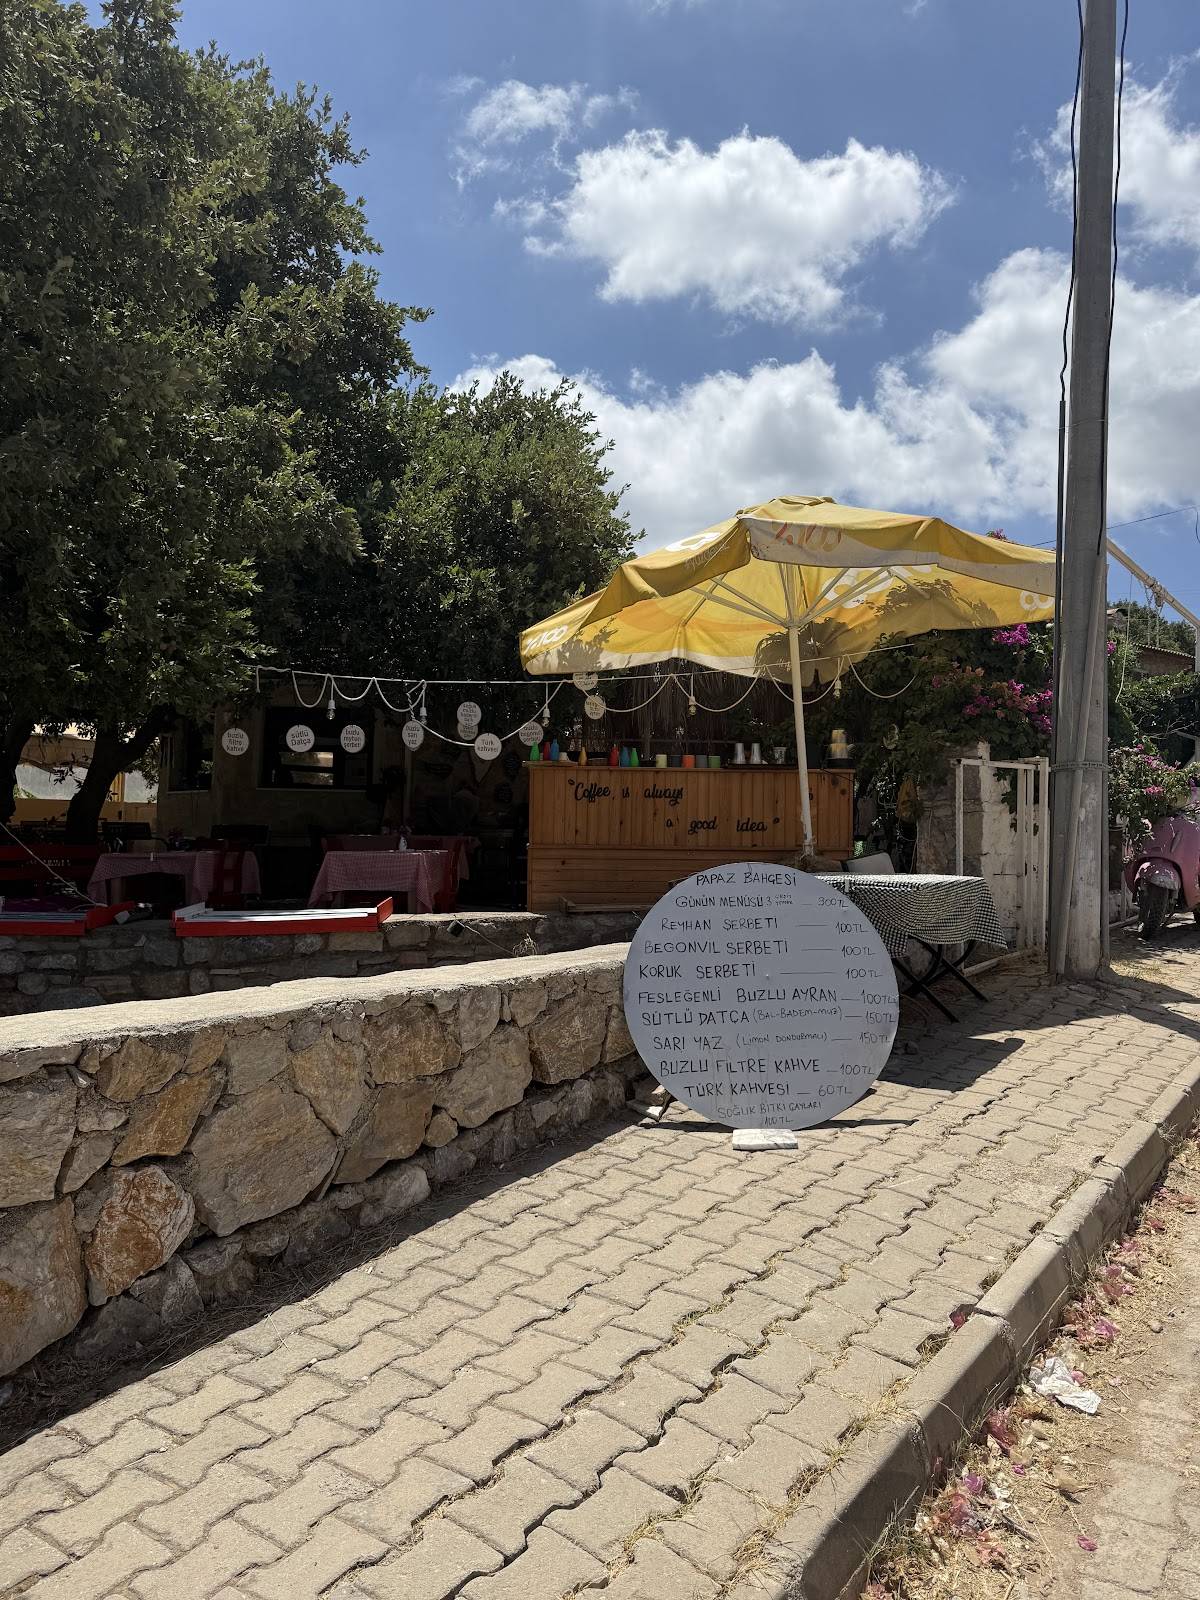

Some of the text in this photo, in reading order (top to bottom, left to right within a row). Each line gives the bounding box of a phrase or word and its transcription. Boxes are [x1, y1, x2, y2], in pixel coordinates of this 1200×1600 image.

[574, 782, 611, 804] Coffee
[644, 784, 684, 807] always
[666, 816, 768, 835] a good idea
[696, 872, 737, 886] PAPAZ
[661, 917, 712, 932] REYHAN
[639, 964, 682, 979] KORUK
[736, 987, 786, 1003] BUZLU
[792, 986, 837, 1002] AYRAN
[653, 1036, 685, 1051] SARI
[694, 1035, 724, 1051] YAZ
[660, 1059, 708, 1077] BUZLU
[774, 1057, 820, 1074] KAHVE
[683, 1082, 724, 1098] TÜRK
